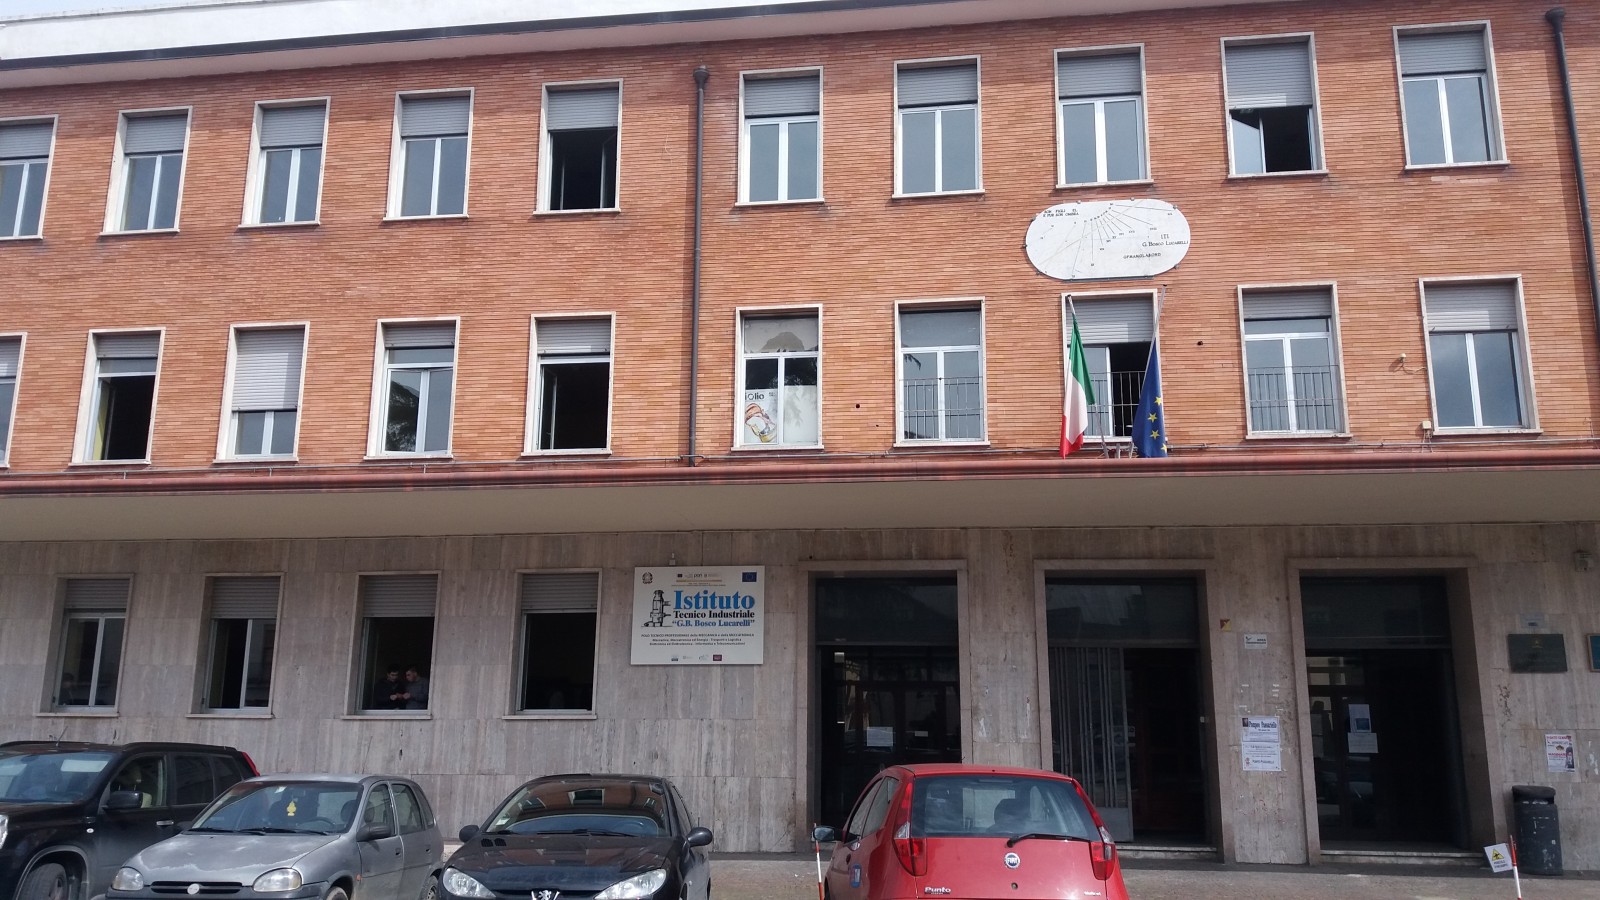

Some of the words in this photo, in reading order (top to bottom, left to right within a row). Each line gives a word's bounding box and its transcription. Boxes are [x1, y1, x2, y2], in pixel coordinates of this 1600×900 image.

[673, 589, 756, 610] Istituto
[673, 610, 707, 619] Tecnico
[708, 609, 755, 619] Industriale
[694, 619, 717, 627] Bosco
